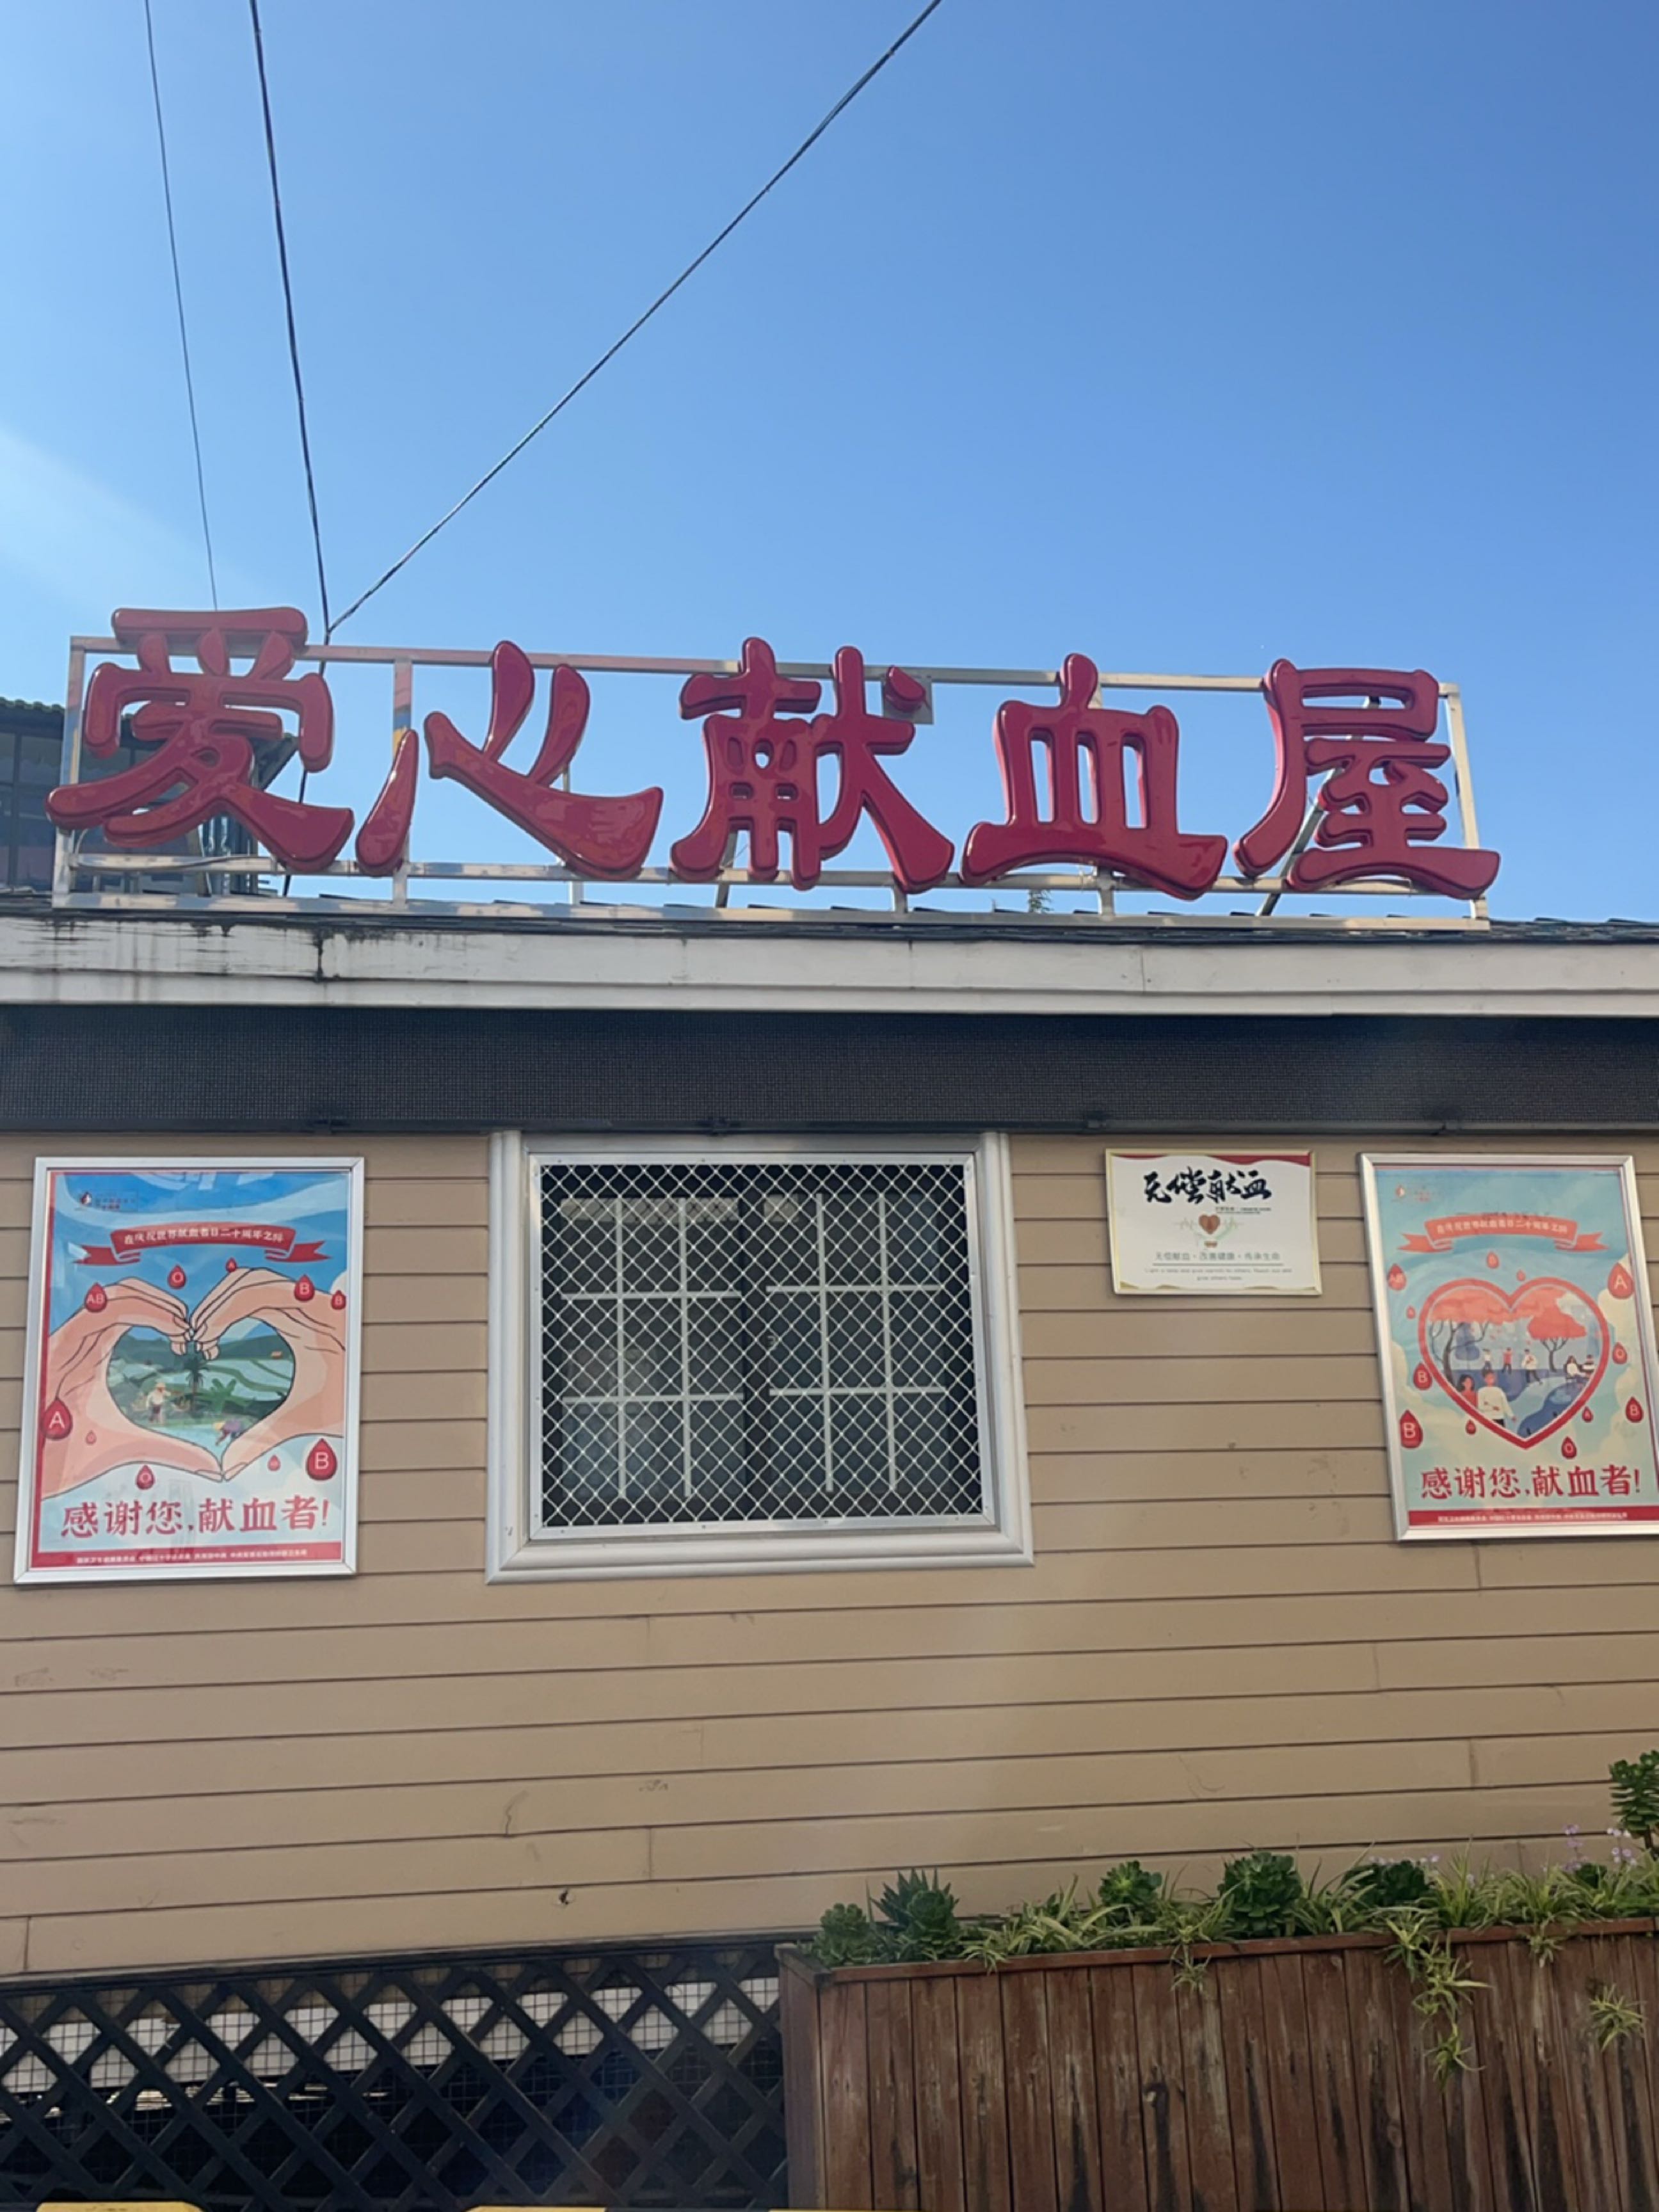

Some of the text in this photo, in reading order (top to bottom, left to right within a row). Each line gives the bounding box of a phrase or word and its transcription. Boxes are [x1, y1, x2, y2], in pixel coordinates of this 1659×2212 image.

[46, 607, 1501, 901] 爱心献血屋
[300, 1283, 310, 1295] B
[1614, 1274, 1628, 1290] A
[86, 1294, 104, 1304] AB
[1418, 1372, 1428, 1383] B
[49, 1411, 65, 1429] A
[1404, 1422, 1416, 1438] B
[315, 1452, 328, 1470] B
